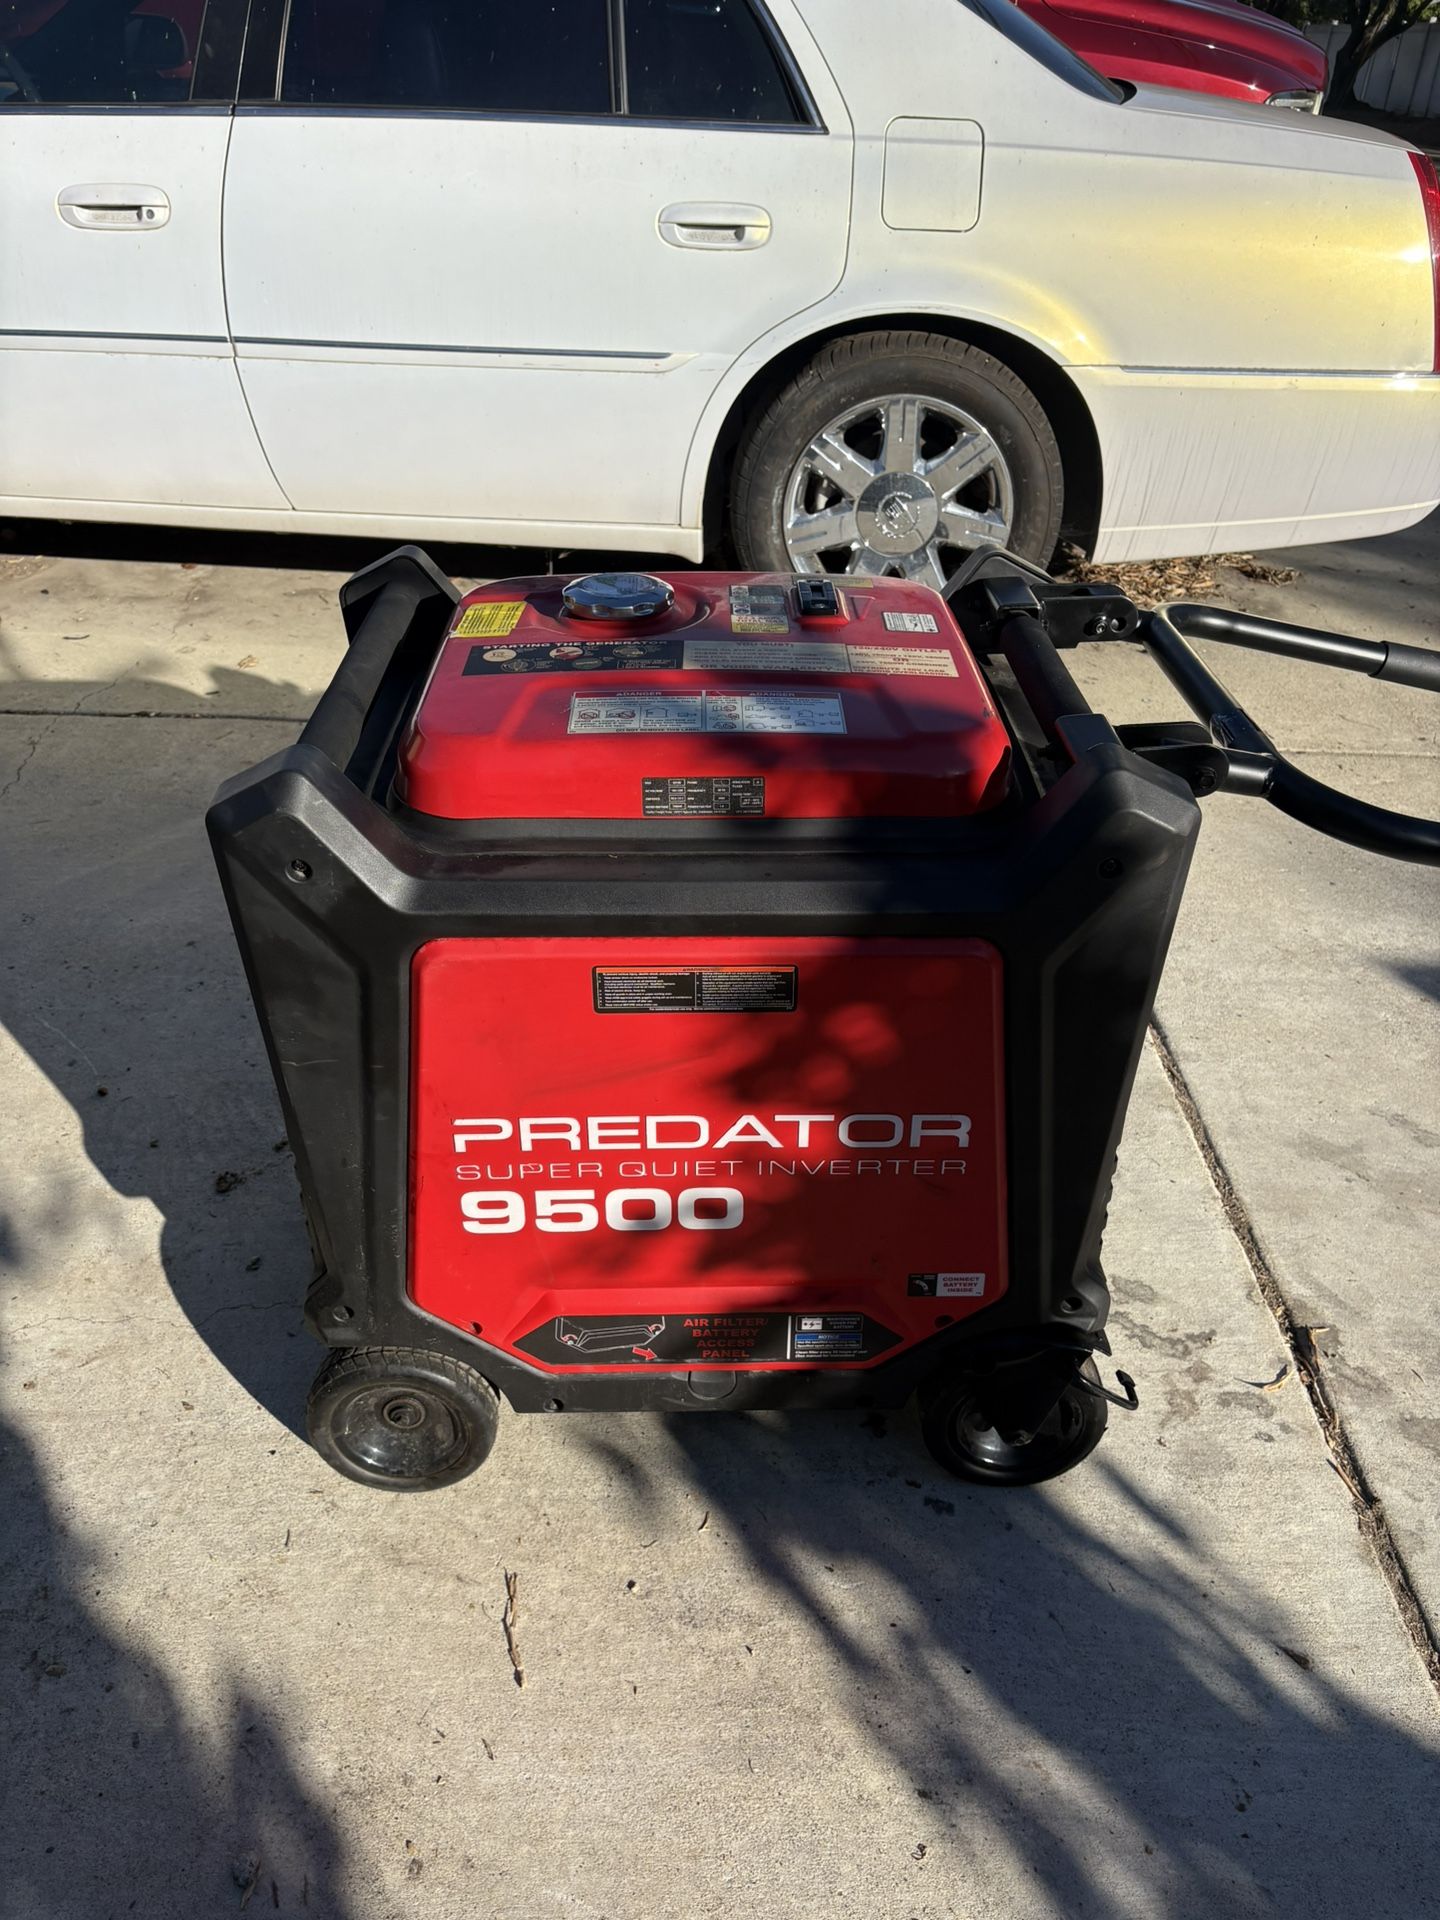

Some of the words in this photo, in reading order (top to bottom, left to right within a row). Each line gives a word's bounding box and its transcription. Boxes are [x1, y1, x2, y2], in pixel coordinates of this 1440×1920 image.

[452, 1113, 972, 1153] PREDATOR
[456, 1162, 603, 1180] SUPER
[619, 1160, 744, 1177] QUIET
[758, 1159, 967, 1176] INVERTER
[460, 1186, 744, 1235] 9500
[683, 1318, 709, 1327] AIR
[712, 1317, 769, 1327] FILTER/
[692, 1328, 760, 1337] BATTERY
[696, 1339, 755, 1348] ACCESS
[702, 1349, 751, 1359] PANEL
